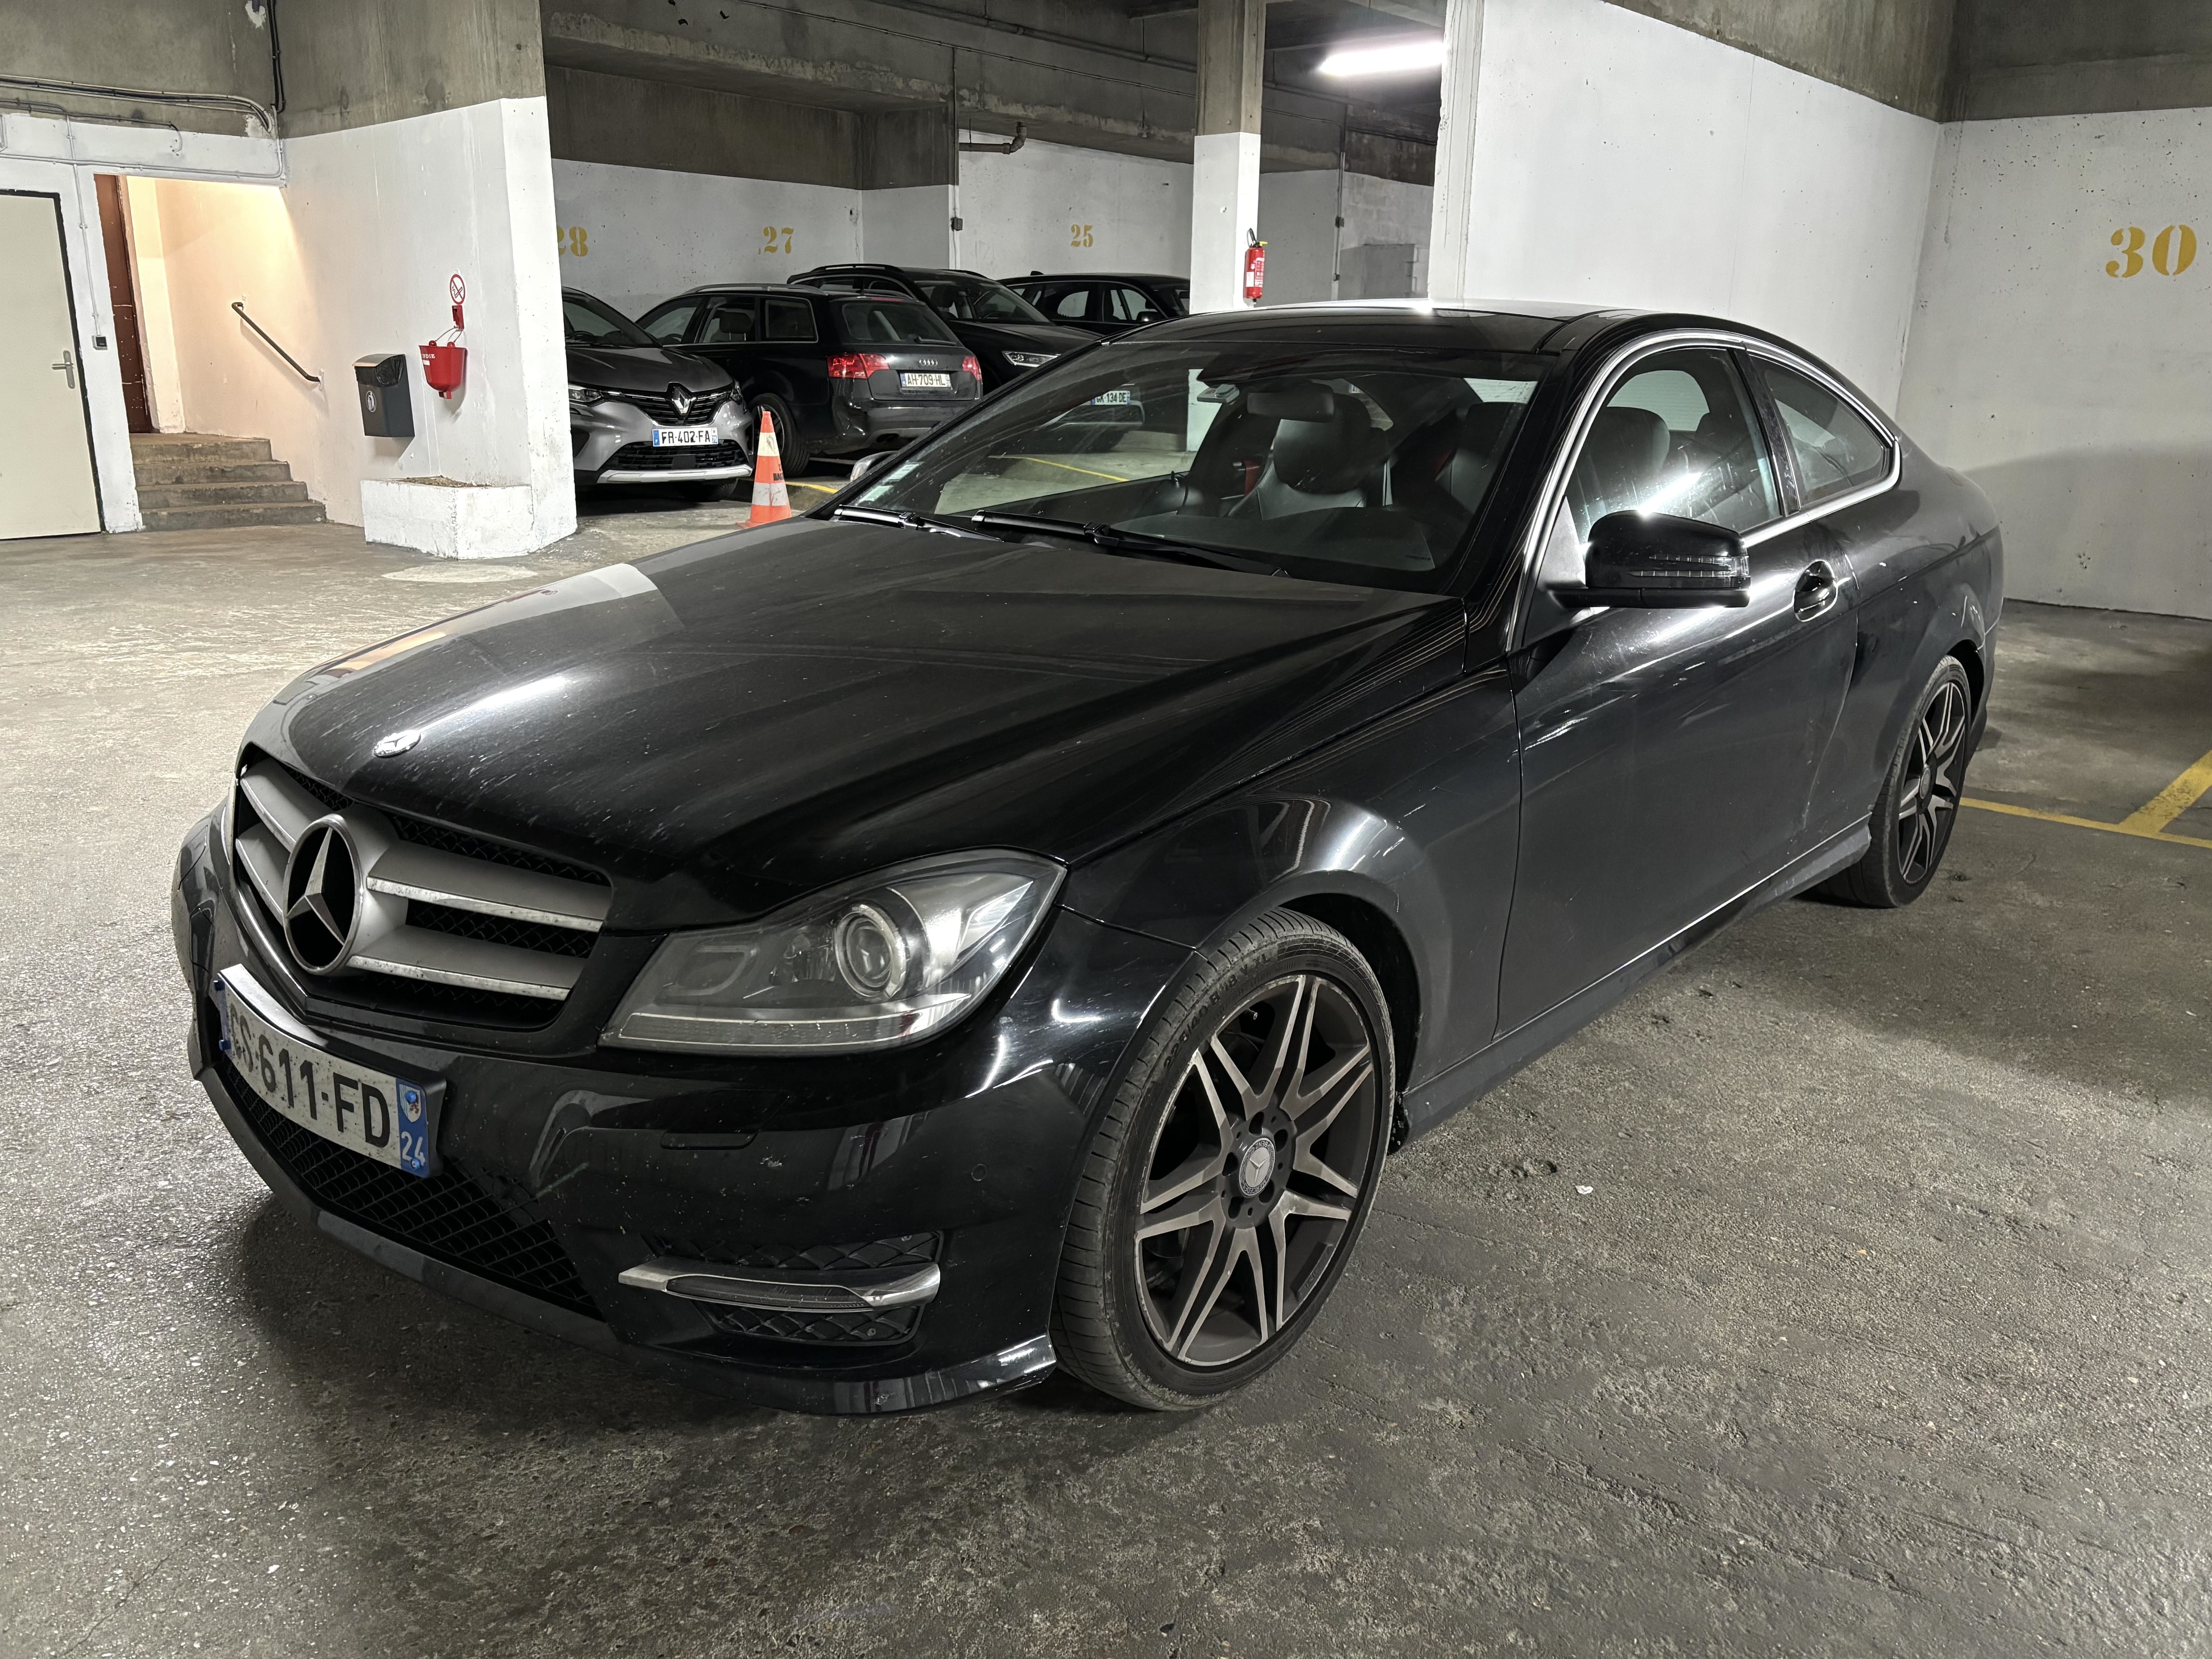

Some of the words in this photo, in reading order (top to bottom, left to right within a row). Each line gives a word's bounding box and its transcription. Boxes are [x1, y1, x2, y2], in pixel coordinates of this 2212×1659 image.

[763, 226, 793, 254] 27
[1071, 224, 1093, 247] 25
[2106, 225, 2197, 278] 30
[402, 1131, 425, 1166] 24
[1254, 1140, 1268, 1149] BENZ
[1242, 1179, 1266, 1194] MERCEDES
